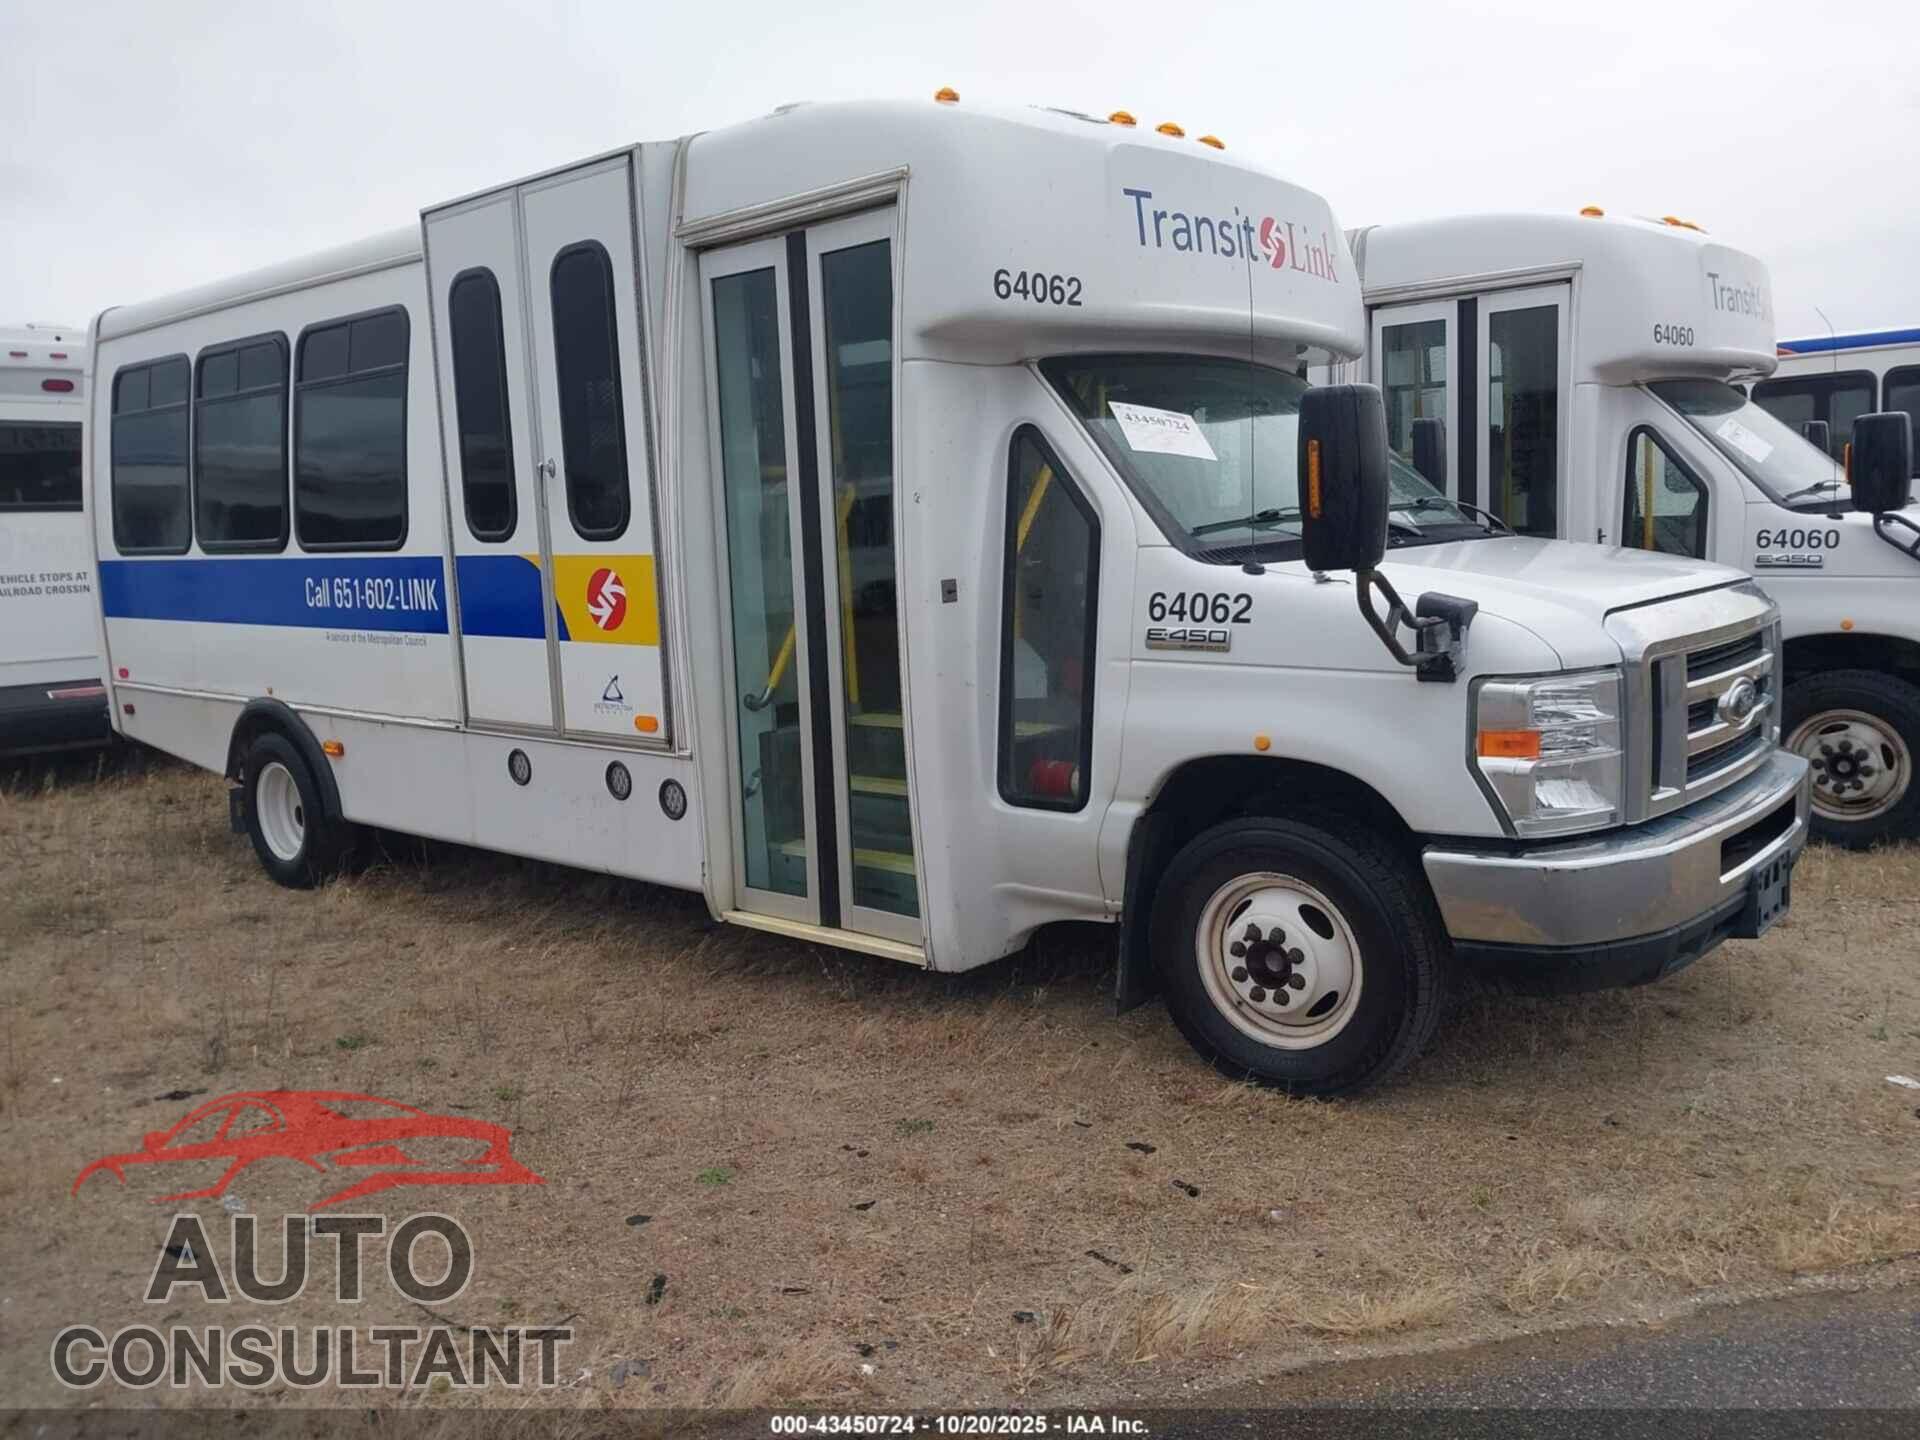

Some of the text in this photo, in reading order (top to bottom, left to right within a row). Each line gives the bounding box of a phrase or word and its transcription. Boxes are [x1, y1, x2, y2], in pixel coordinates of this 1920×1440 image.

[1122, 187, 1339, 283] Transit Link
[993, 268, 1083, 306] 64062
[1653, 323, 1695, 346] 64060
[1756, 529, 1841, 549] 64060
[1755, 554, 1823, 565] E-450
[0, 572, 88, 584] EHICLE STOPS AT
[0, 587, 42, 597] AILROAD
[305, 577, 439, 611] Call 651-602-LINK
[1148, 591, 1253, 624] 64062
[1147, 628, 1228, 643] E-450
